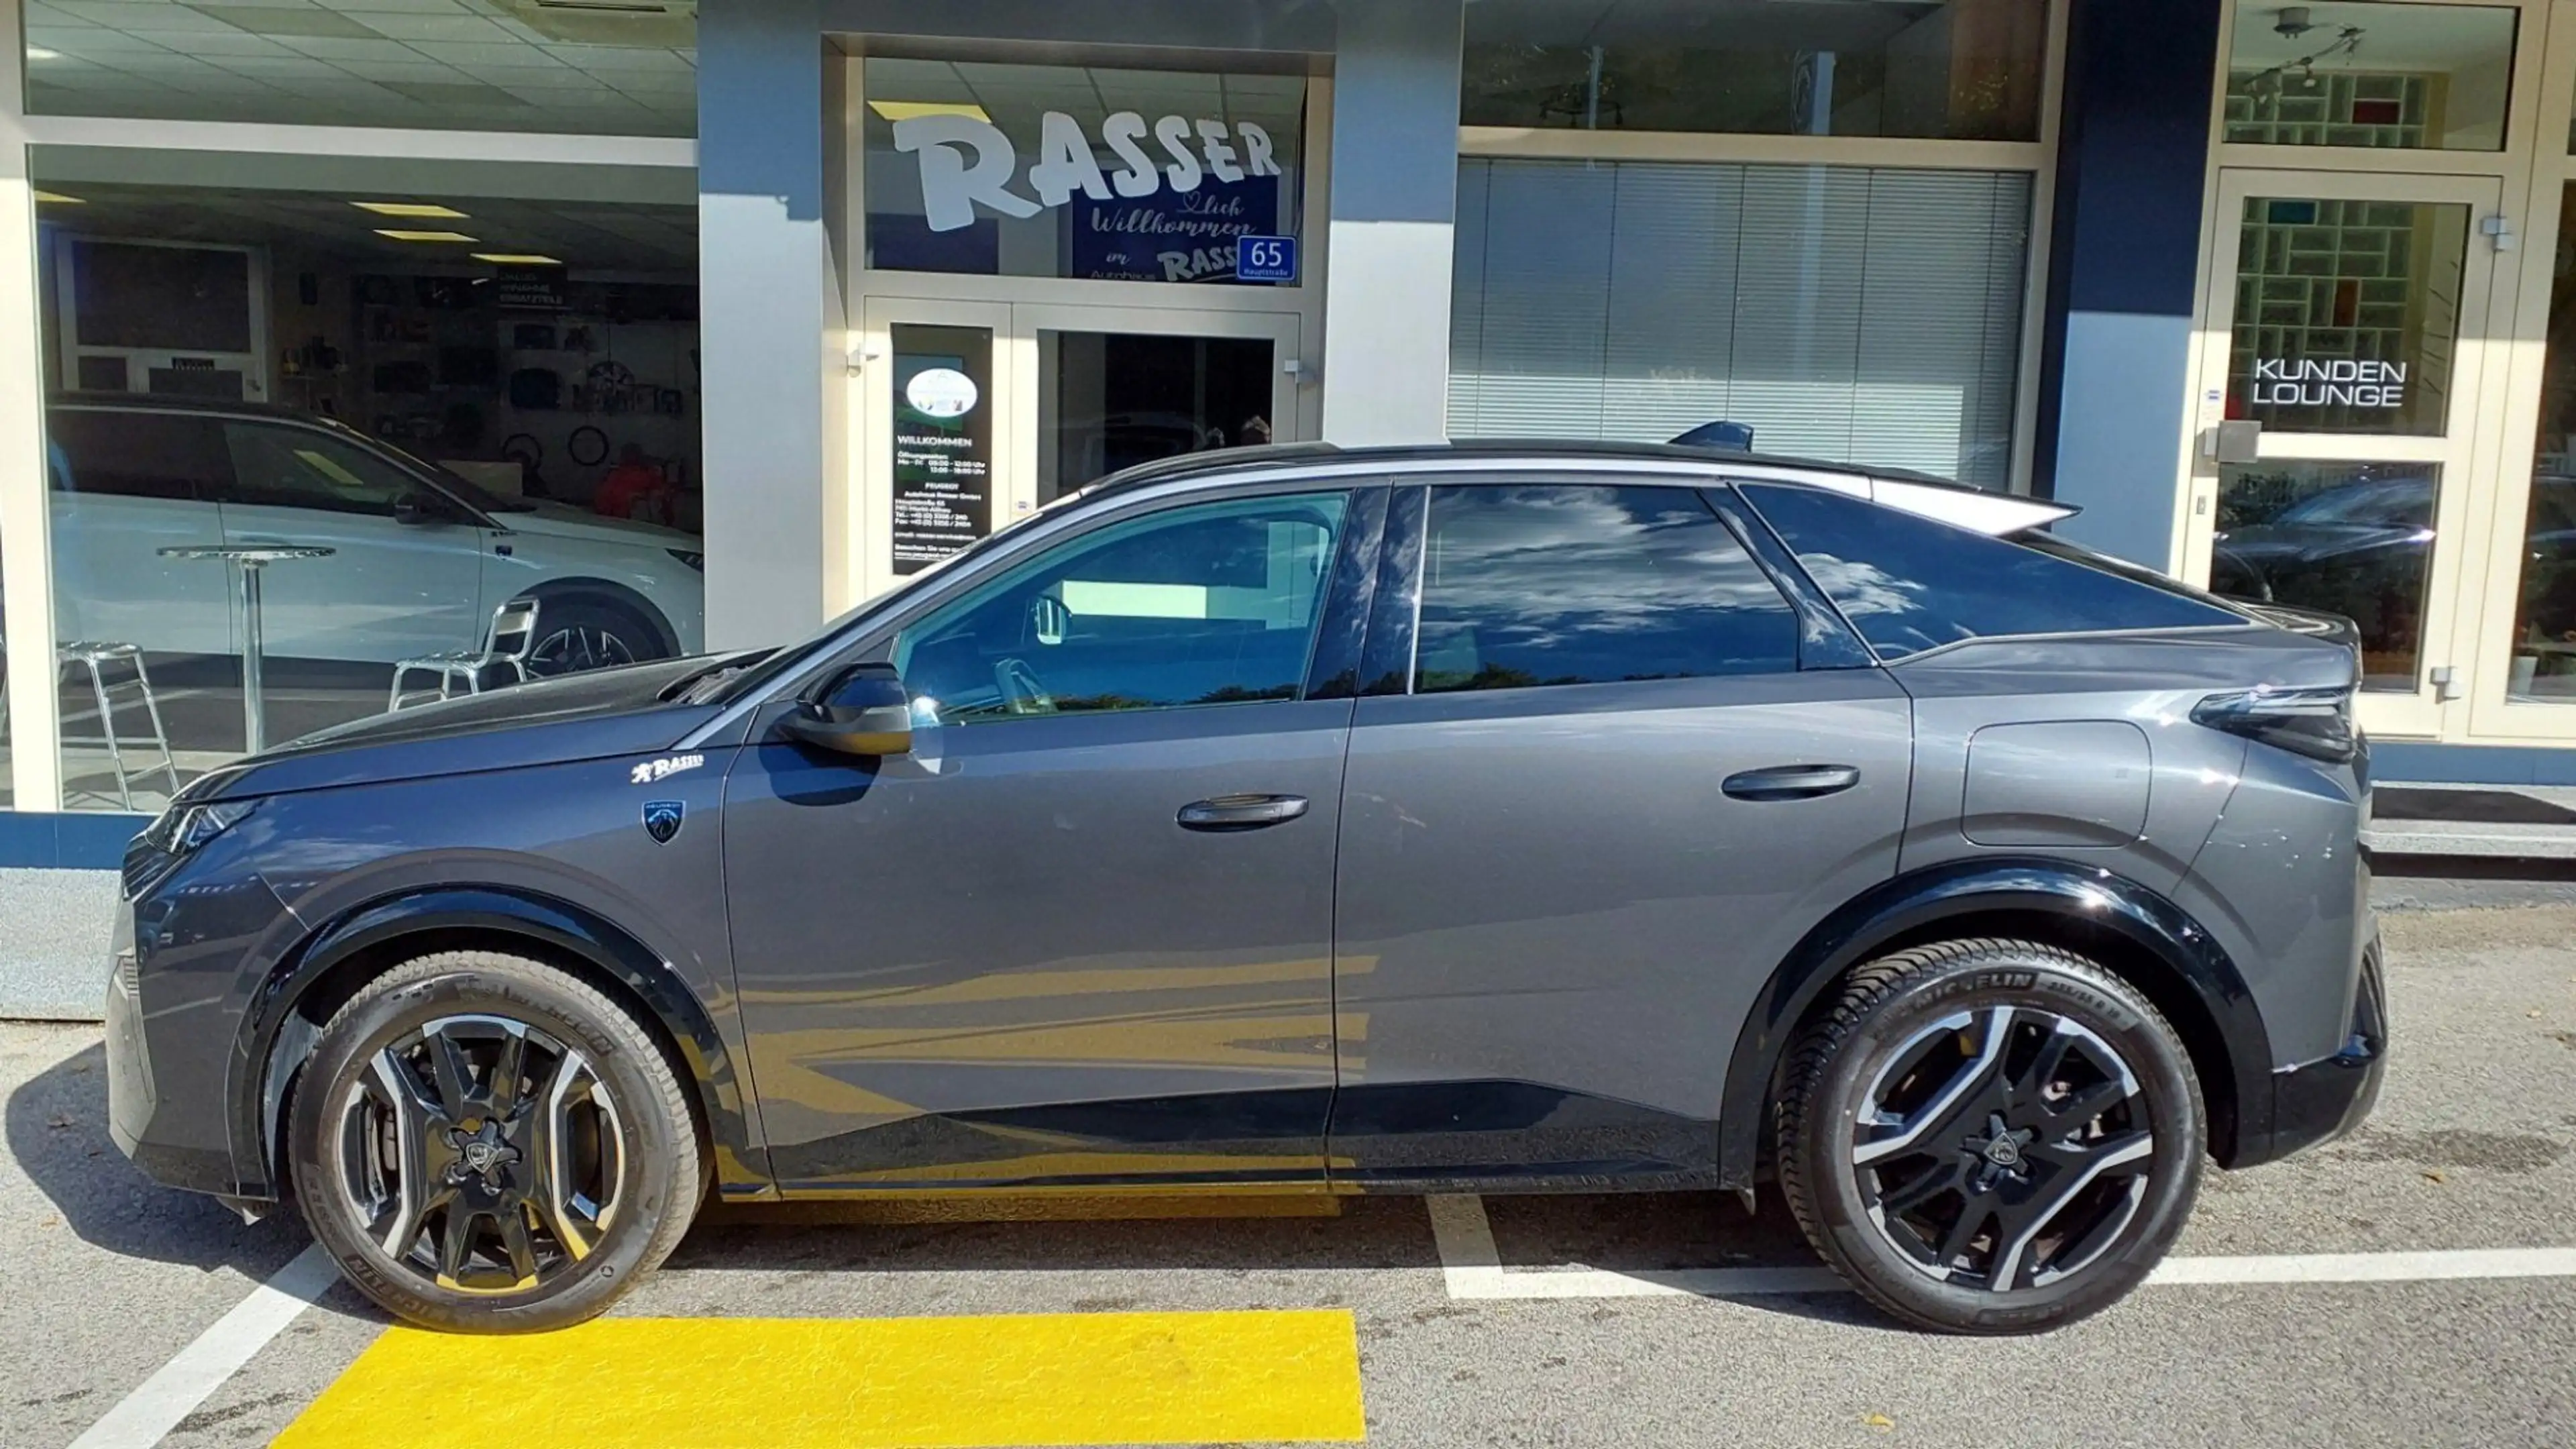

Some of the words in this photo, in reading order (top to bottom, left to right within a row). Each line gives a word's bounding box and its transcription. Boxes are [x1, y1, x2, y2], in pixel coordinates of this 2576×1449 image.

[893, 111, 1281, 232] RASSER
[1091, 207, 1256, 236] Willkommen
[1157, 246, 1238, 282] RASS
[1251, 241, 1282, 267] 65
[2255, 358, 2407, 382] KUNDEN
[2253, 383, 2404, 407] LOUNGE
[898, 435, 972, 447] WILLKOMMEN
